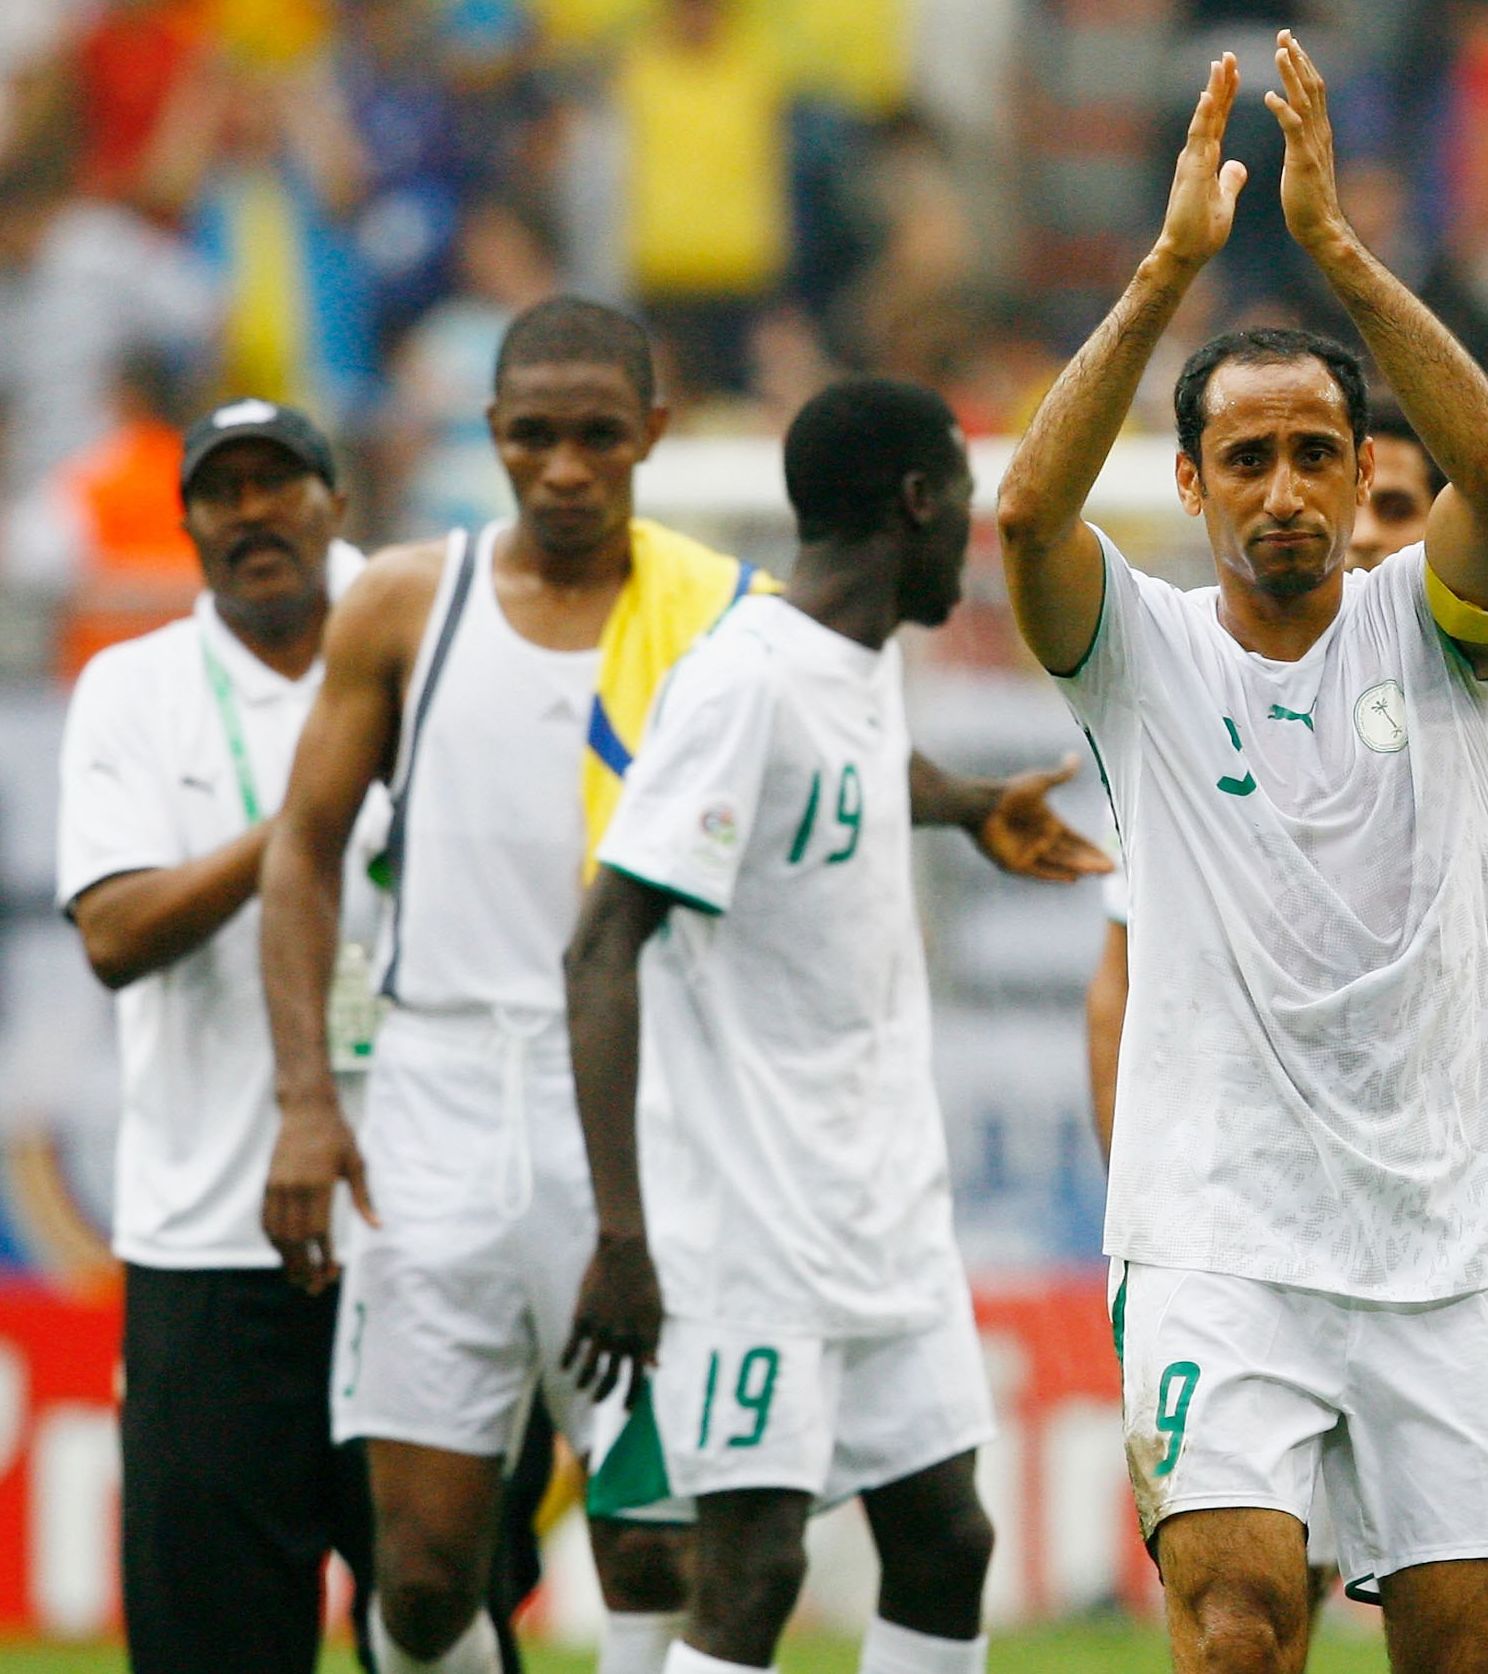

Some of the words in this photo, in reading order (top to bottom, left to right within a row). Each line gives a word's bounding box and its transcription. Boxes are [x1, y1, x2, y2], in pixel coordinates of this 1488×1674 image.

[788, 764, 862, 865] 19
[698, 1346, 780, 1449] 19
[1154, 1360, 1201, 1478] 9
